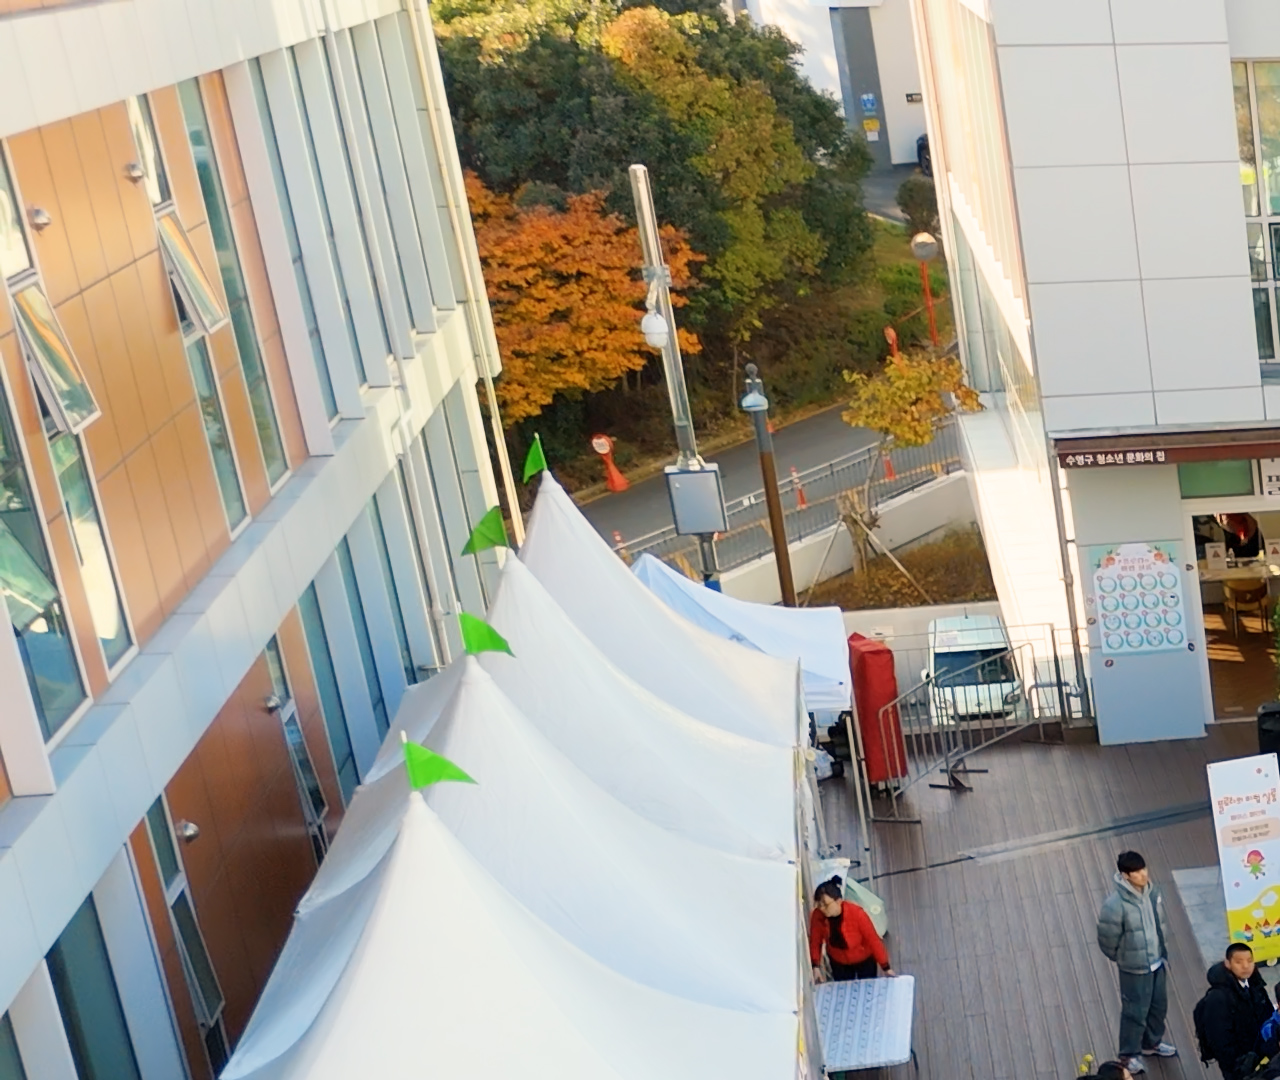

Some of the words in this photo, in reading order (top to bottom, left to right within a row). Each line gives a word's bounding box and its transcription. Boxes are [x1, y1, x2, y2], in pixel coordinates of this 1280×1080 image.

[1066, 454, 1094, 466] 수영구
[1096, 452, 1124, 465] 청소년
[1126, 451, 1153, 463] 문화의
[1155, 450, 1165, 462] 집
